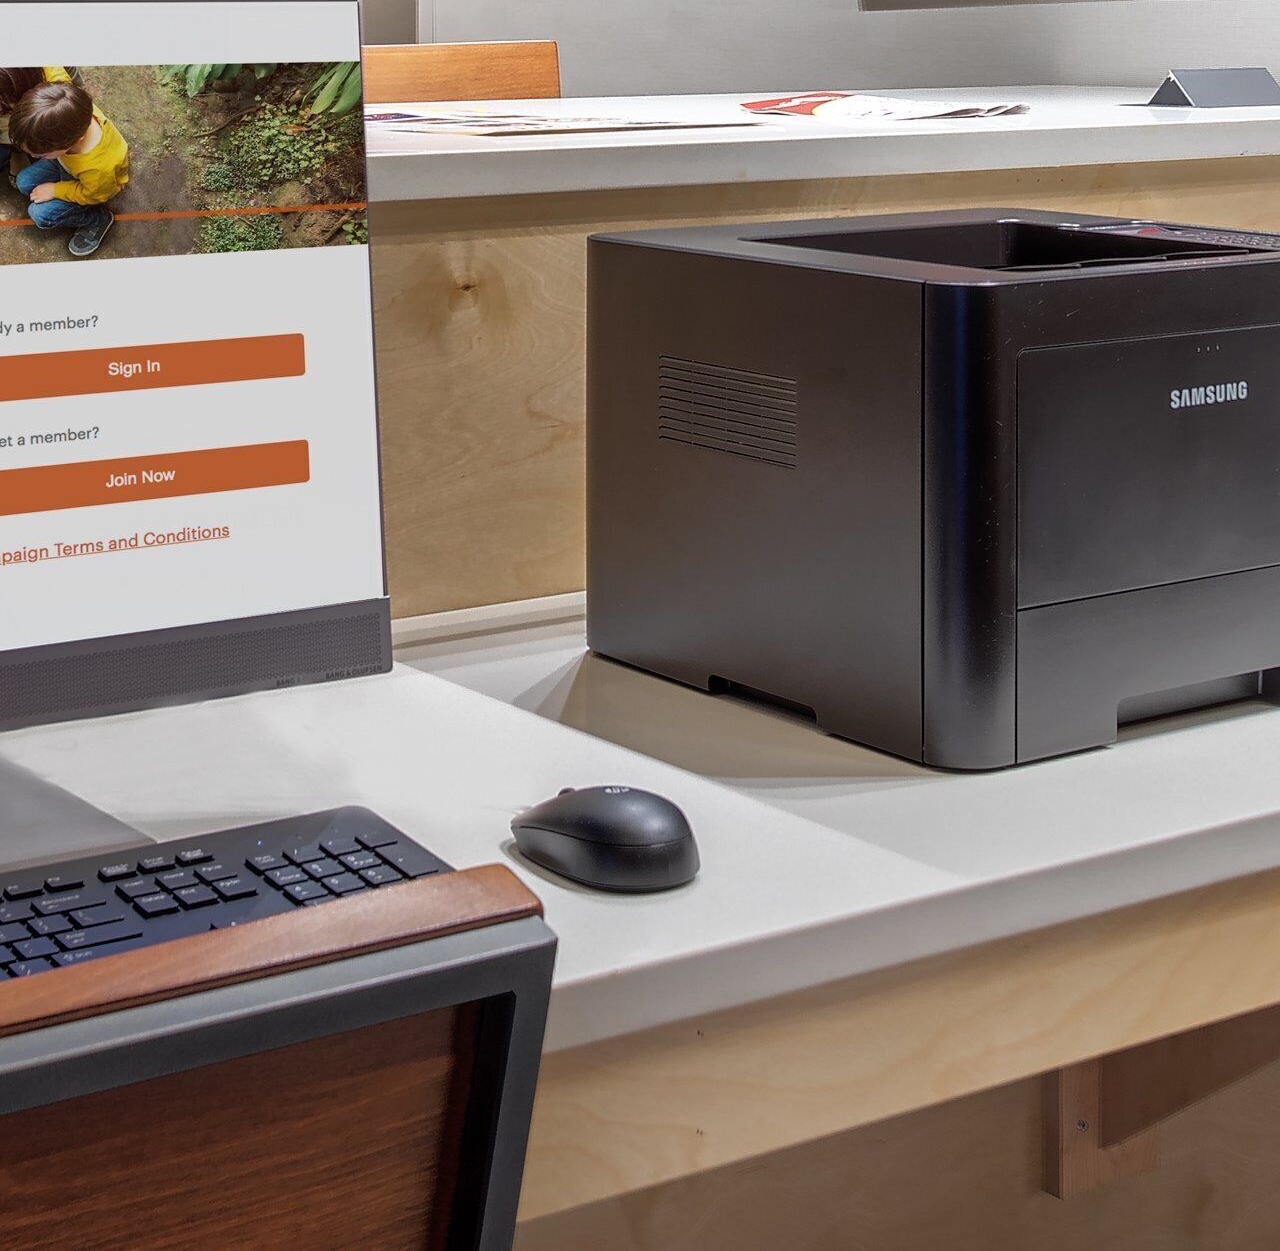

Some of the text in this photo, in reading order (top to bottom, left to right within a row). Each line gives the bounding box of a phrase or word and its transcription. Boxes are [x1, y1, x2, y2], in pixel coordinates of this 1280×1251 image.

[16, 323, 25, 333] a
[29, 315, 99, 332] member?
[107, 359, 161, 379] Sign In
[1170, 381, 1247, 409] SAMSUNG
[17, 436, 26, 446] a
[30, 426, 100, 445] member?
[105, 469, 176, 488] Join Now
[53, 541, 105, 556] Terms
[108, 532, 139, 550] and
[142, 526, 230, 545] Conditions
